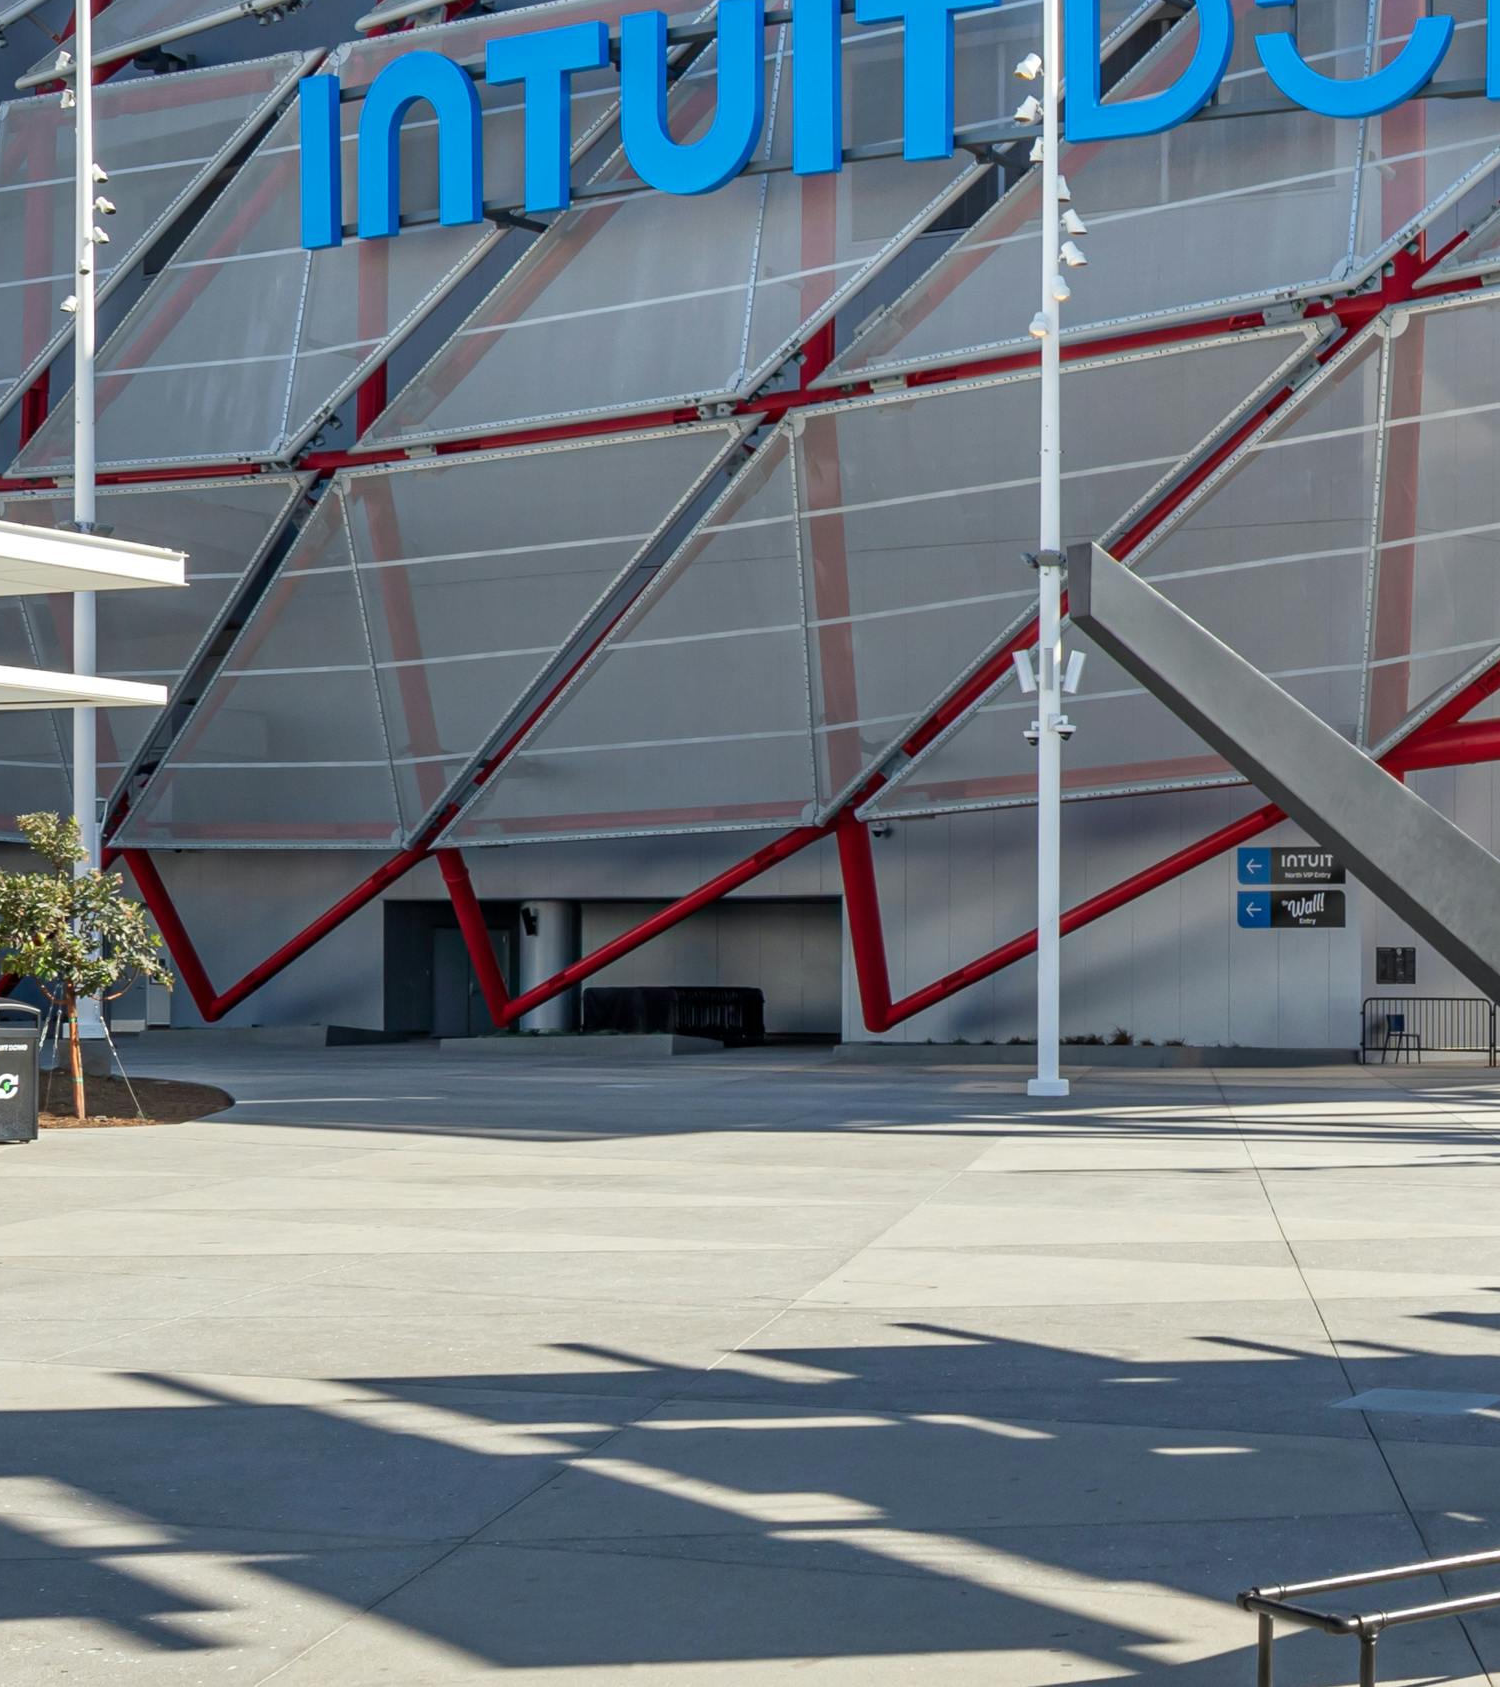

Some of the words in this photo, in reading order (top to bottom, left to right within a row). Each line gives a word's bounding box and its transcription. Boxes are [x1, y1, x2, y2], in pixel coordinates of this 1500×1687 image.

[1281, 854, 1334, 868] INTUIT
[1287, 892, 1325, 918] Wall!
[1299, 917, 1317, 925] Entry
